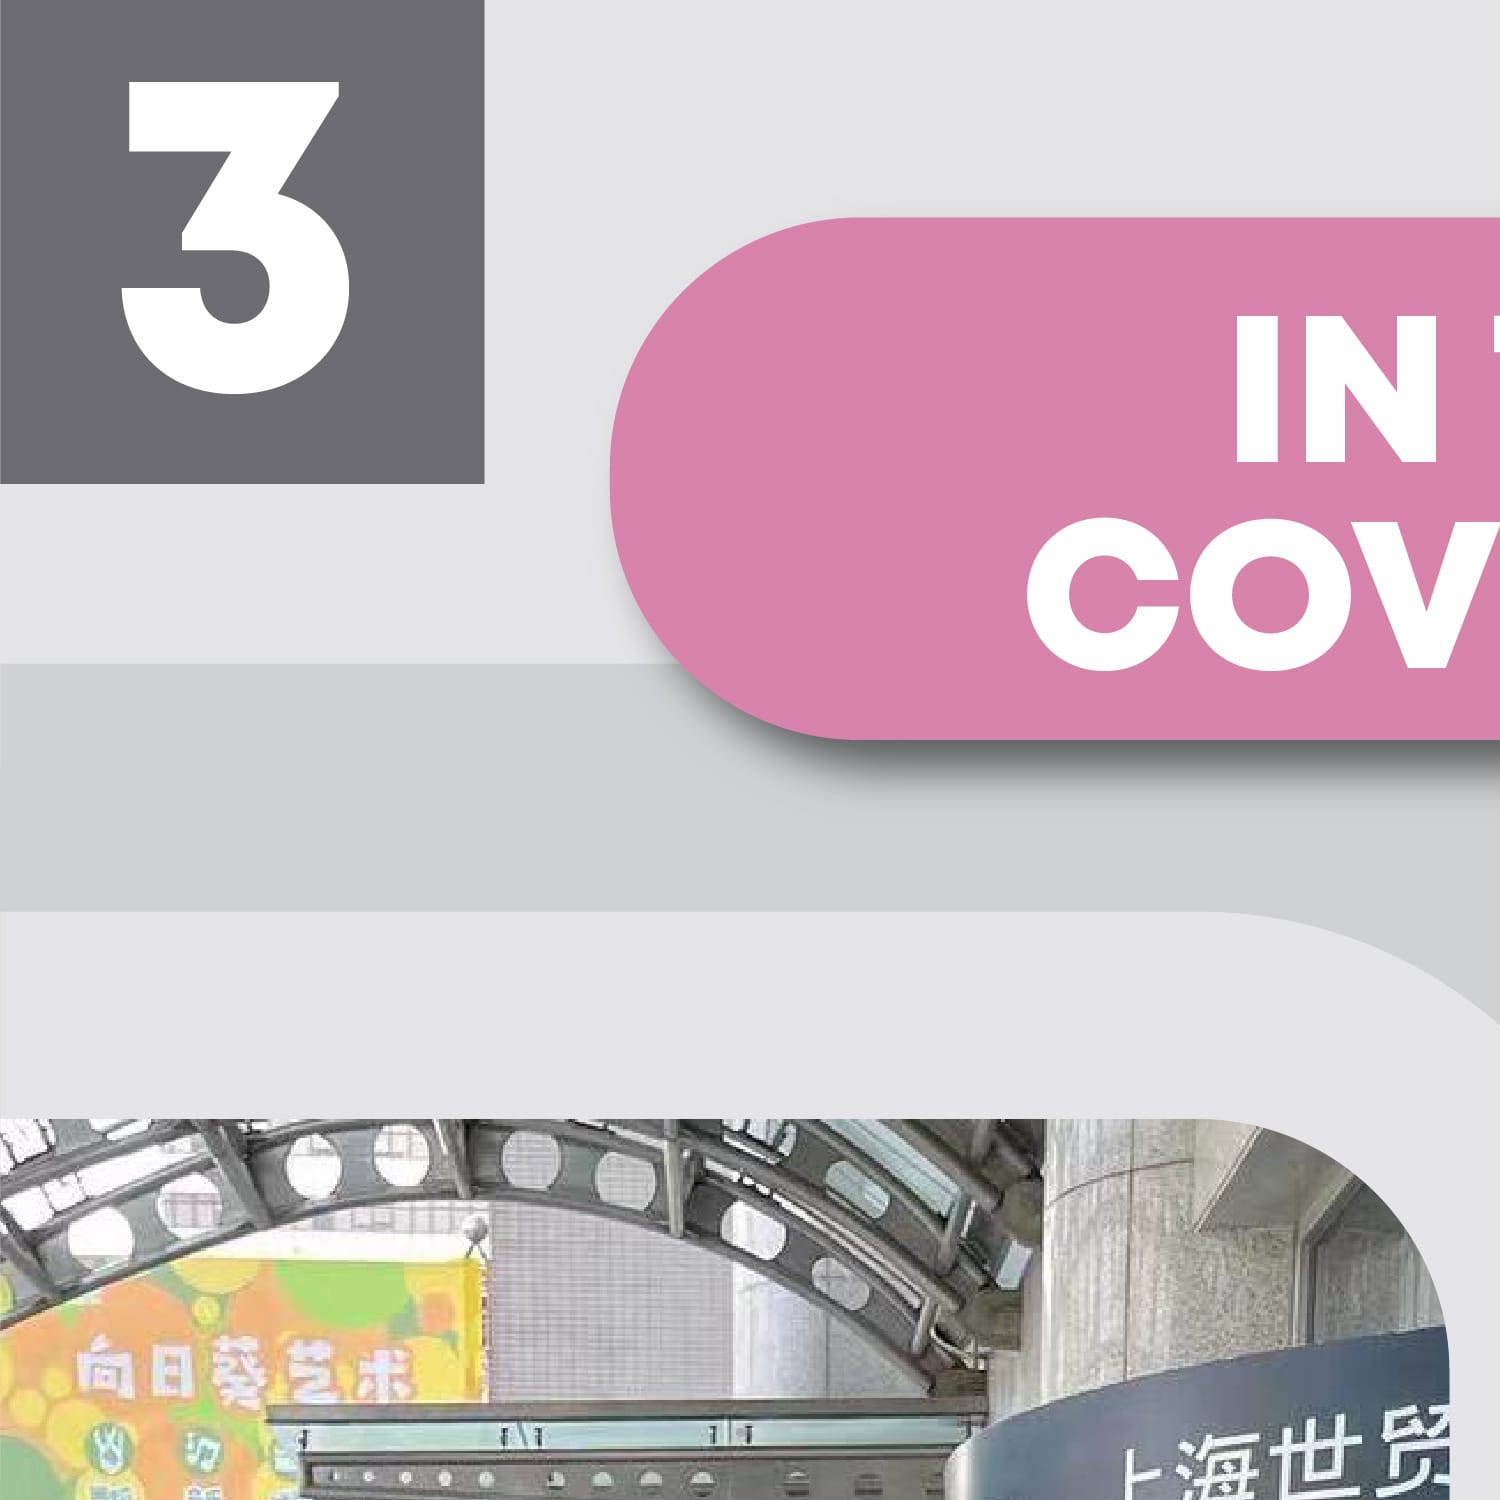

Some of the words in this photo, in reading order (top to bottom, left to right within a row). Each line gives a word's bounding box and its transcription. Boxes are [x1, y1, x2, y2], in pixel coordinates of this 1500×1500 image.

[76, 1334, 414, 1411] 向日葵艺术
